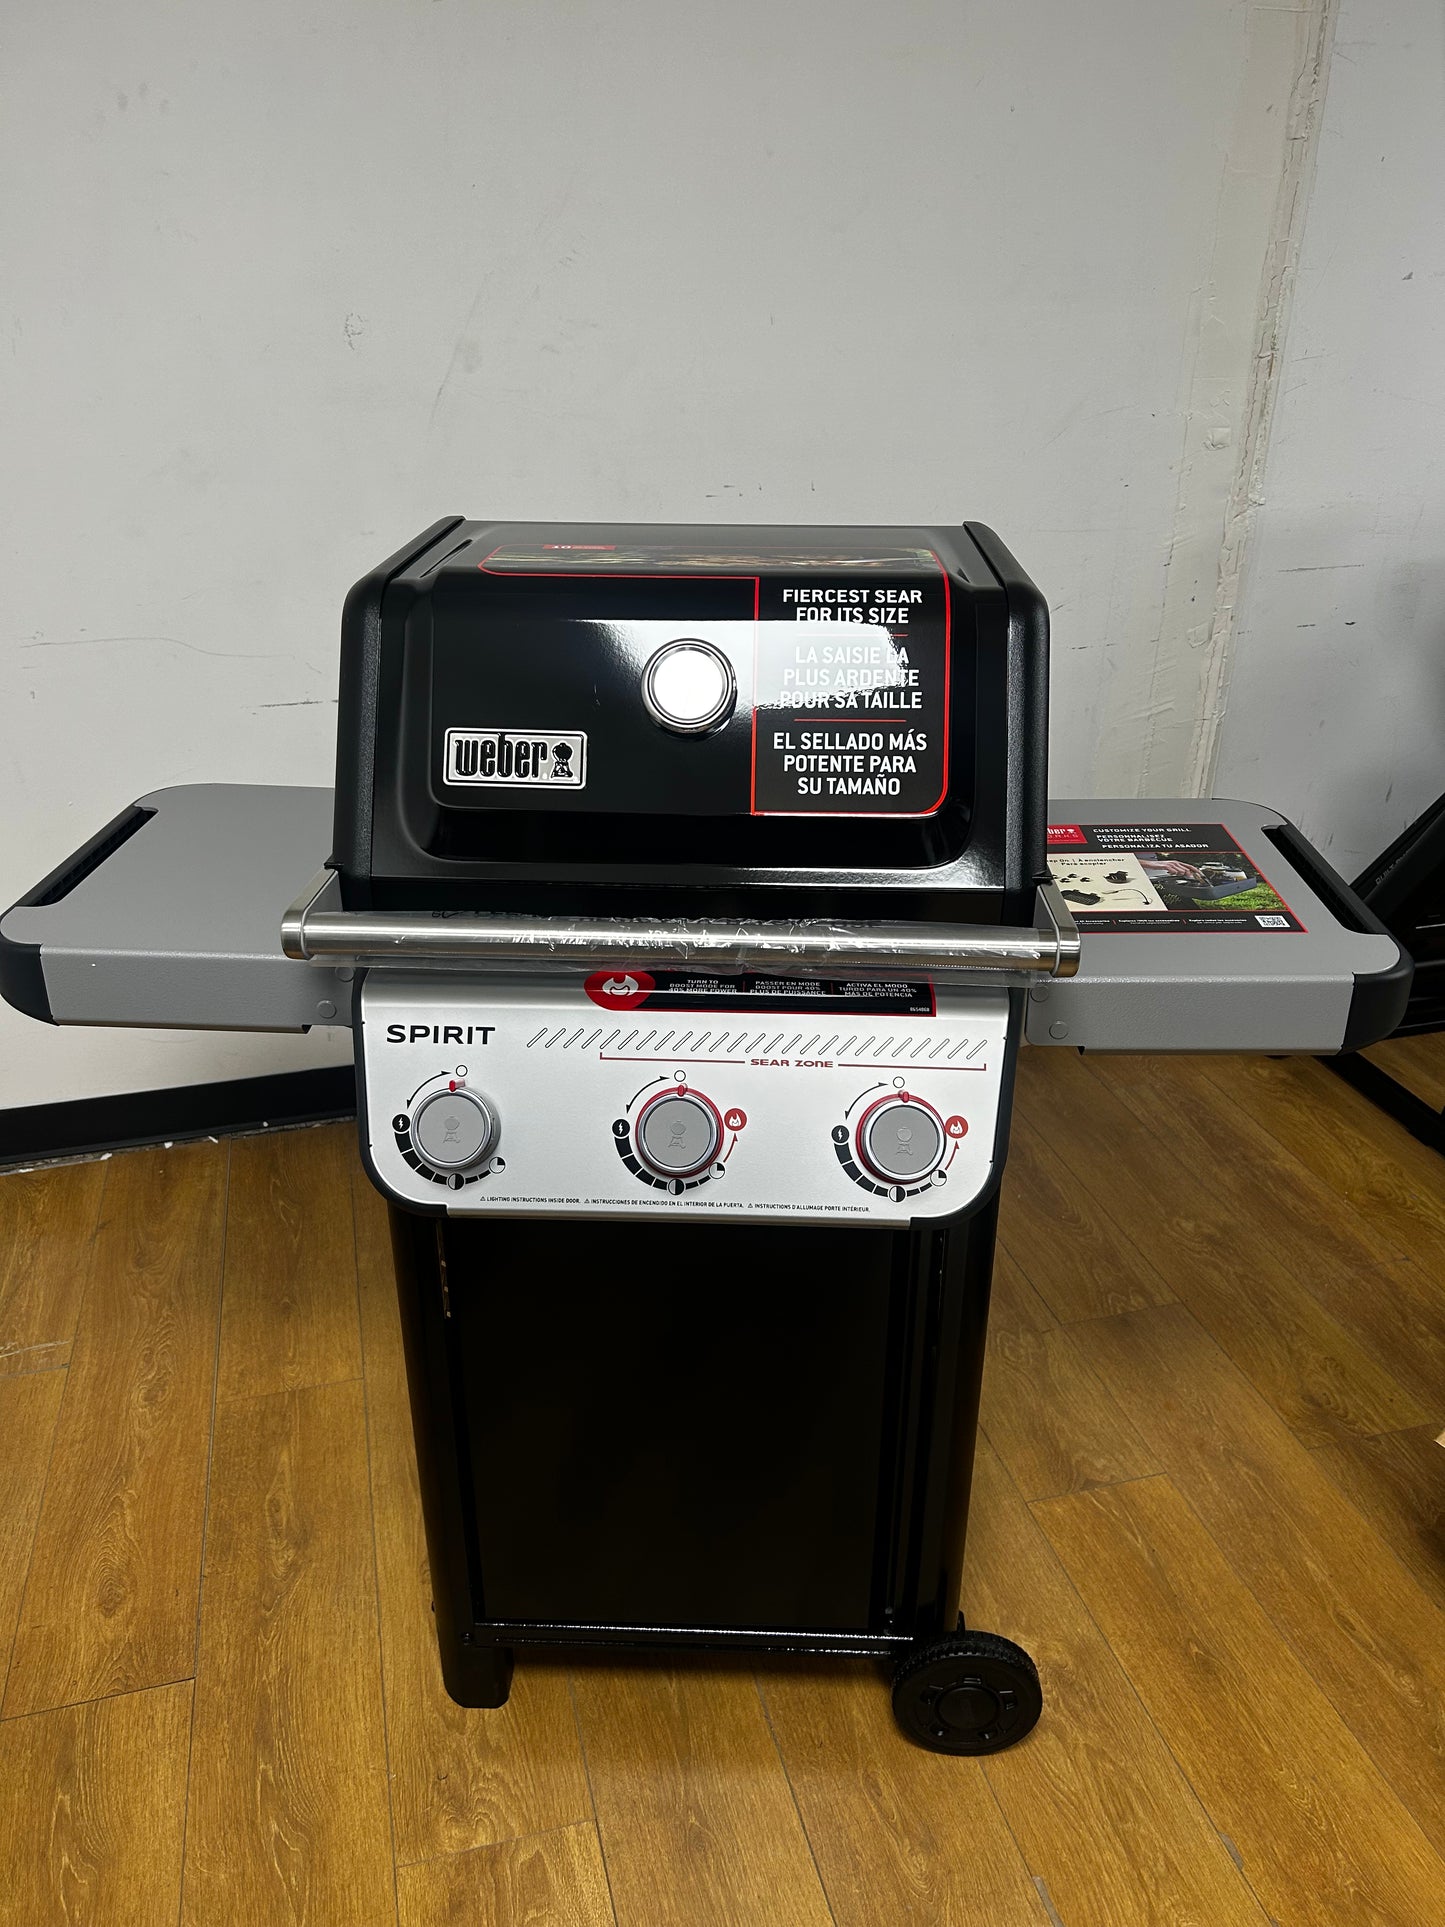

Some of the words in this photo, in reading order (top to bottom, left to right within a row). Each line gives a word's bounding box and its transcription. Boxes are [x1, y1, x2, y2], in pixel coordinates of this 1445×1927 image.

[782, 588, 870, 604] FIERCEST
[874, 589, 923, 604] SEAR
[796, 607, 831, 622] FOR
[837, 607, 864, 623] ITS
[868, 607, 909, 624] SIZE
[795, 646, 819, 664] LA
[823, 646, 881, 664] SAISIE
[886, 646, 910, 664] LA
[783, 668, 830, 686] PLUS
[834, 668, 920, 687] ARDENTE
[780, 691, 830, 709] POUR
[834, 691, 859, 709] SA
[861, 691, 923, 709] TAILLE
[773, 732, 796, 750] EL
[800, 732, 884, 751] SELLADO
[889, 728, 928, 751] MÁS
[454, 732, 548, 778] weber
[783, 754, 865, 773] POTENTE
[869, 755, 917, 773] PARA
[797, 777, 822, 795] SU
[827, 773, 901, 796] TAMAÑO
[1047, 827, 1066, 835] ber
[386, 1024, 496, 1045] SPIRIT
[750, 1058, 792, 1067] SEAR
[794, 1060, 834, 1068] ZONE
